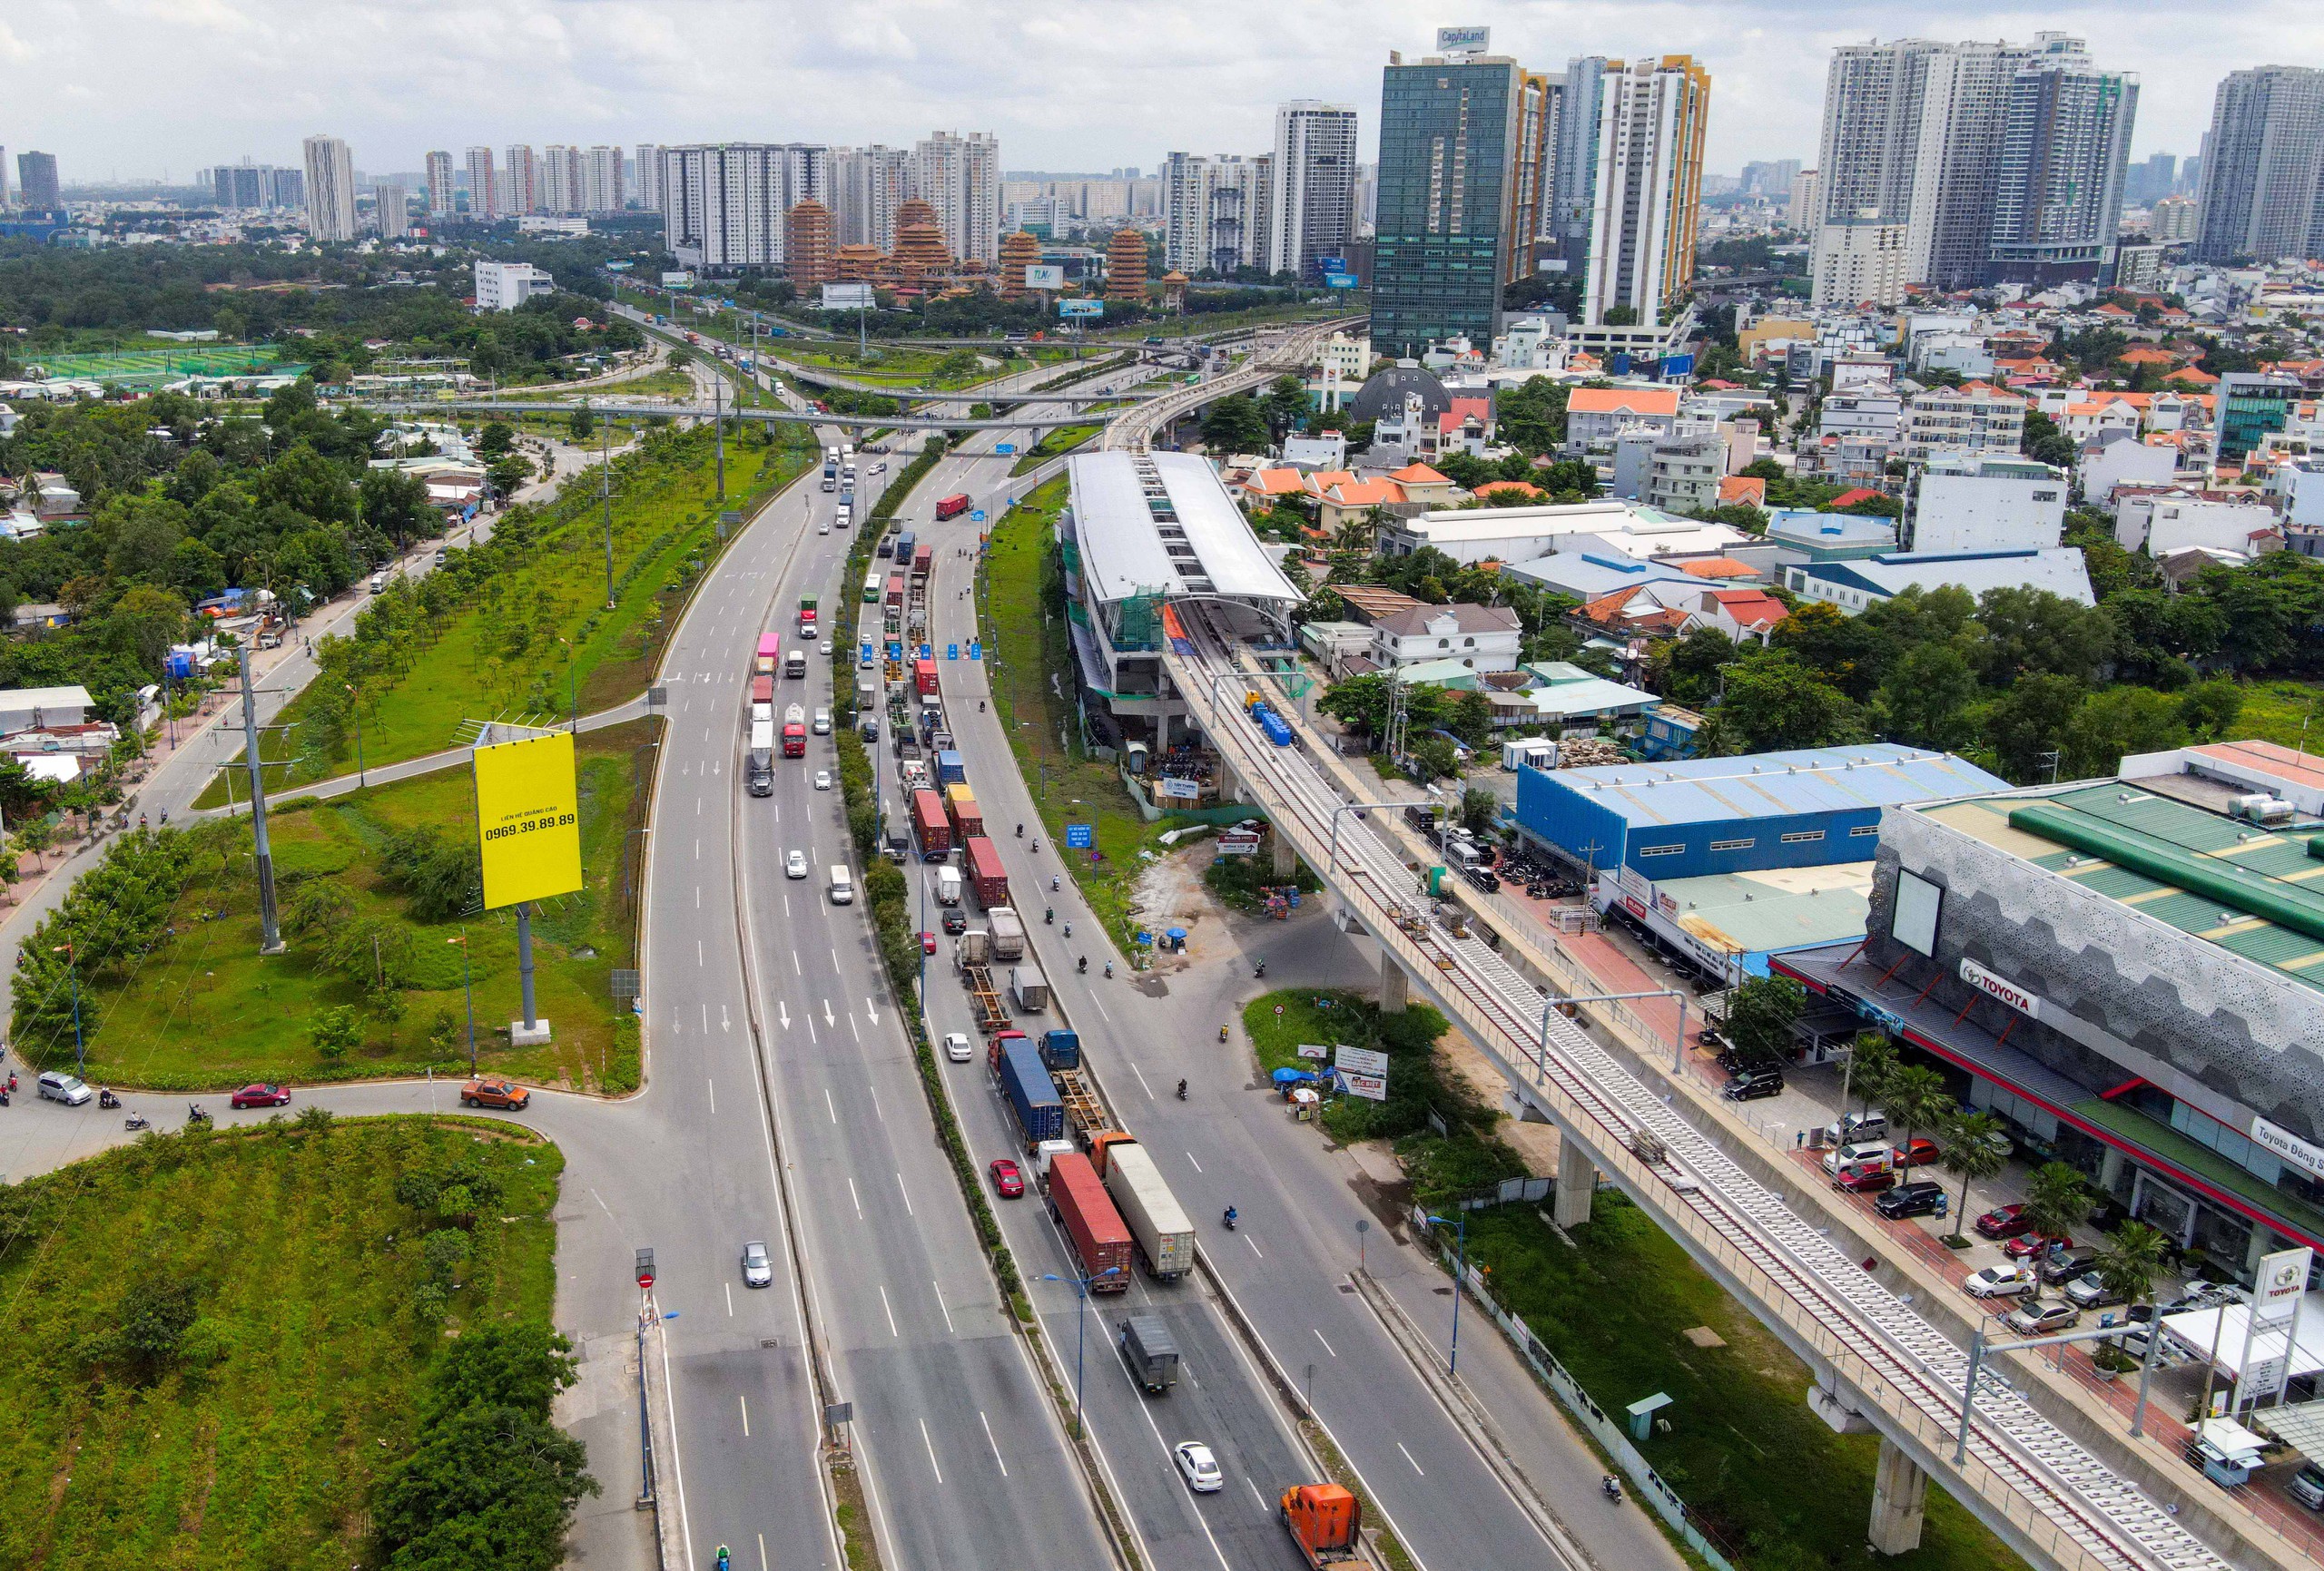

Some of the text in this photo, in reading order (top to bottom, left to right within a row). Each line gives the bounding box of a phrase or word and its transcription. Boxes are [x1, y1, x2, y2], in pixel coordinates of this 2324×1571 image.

[1442, 28, 1485, 44] CapitaLand
[486, 813, 575, 841] 0969.39.89.89
[1982, 976, 2030, 1012] TOYOTA
[2259, 1125, 2289, 1151] Toyota
[2290, 1144, 2316, 1167] Đông
[2269, 1284, 2300, 1298] TOYOTA
